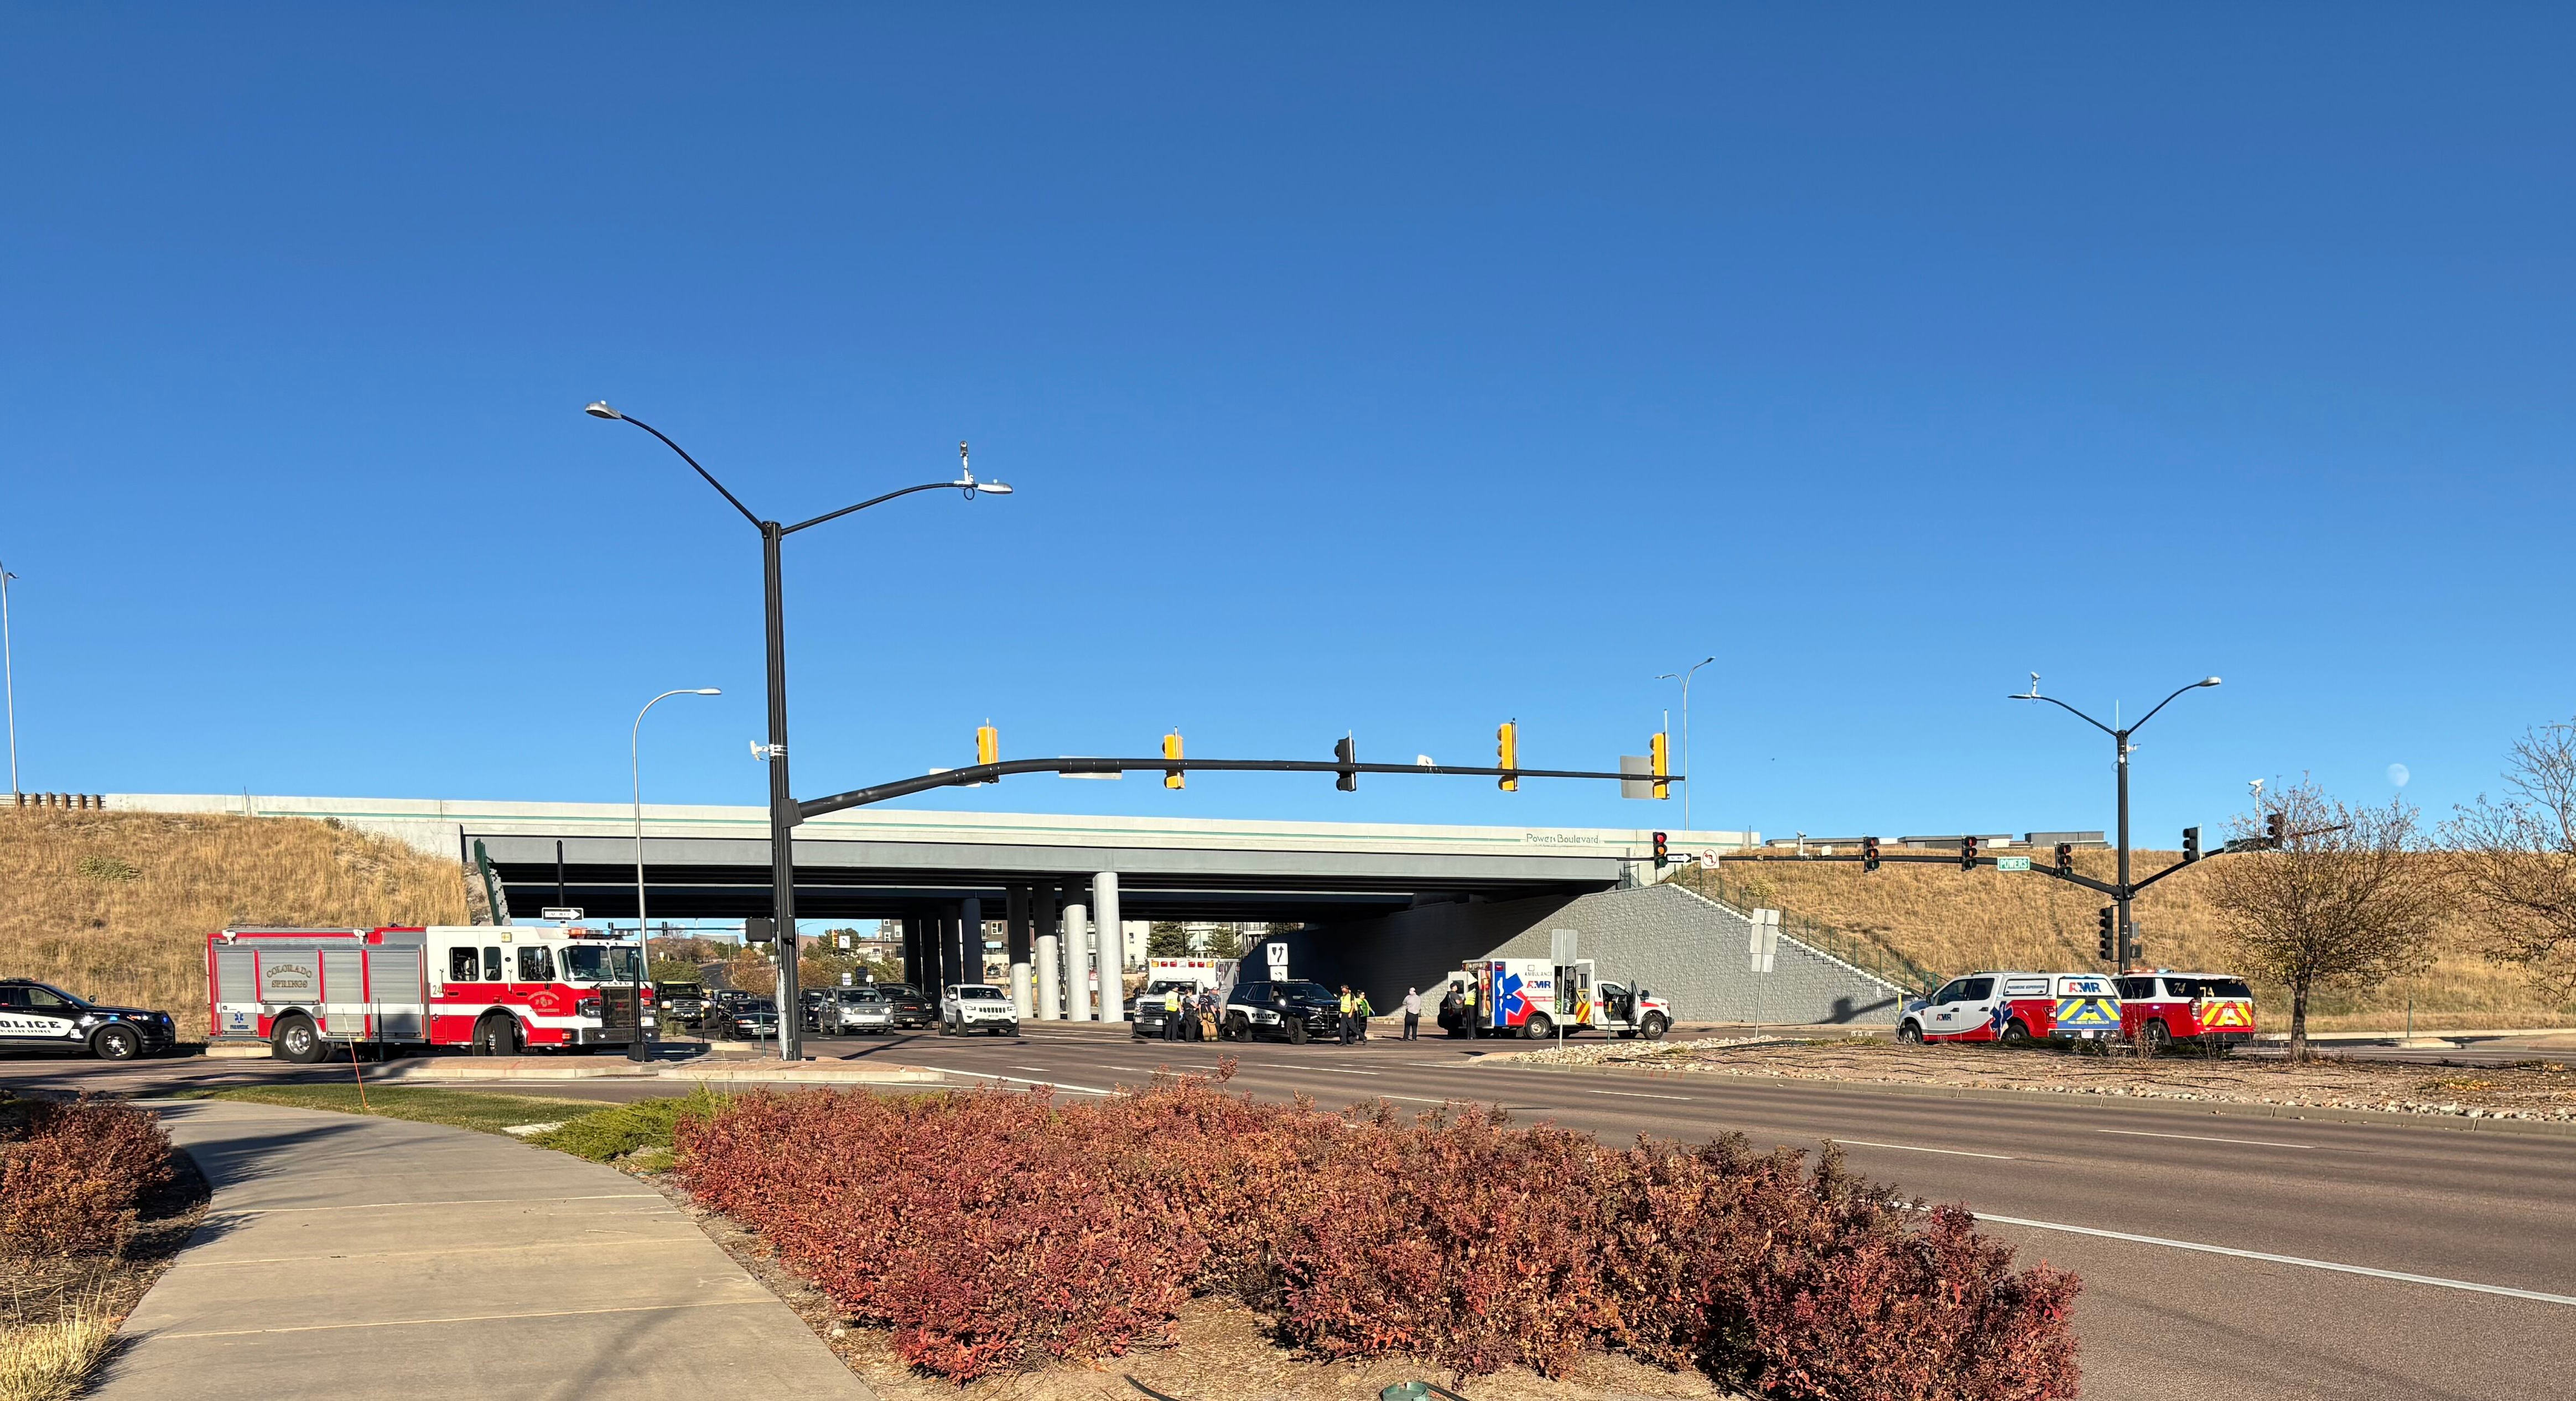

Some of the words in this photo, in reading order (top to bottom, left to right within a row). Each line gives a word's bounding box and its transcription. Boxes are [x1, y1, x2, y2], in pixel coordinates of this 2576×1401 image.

[1557, 834, 1598, 843] Boulevard
[1999, 859, 2028, 868] POWERS
[267, 964, 313, 978] COLORADO
[433, 985, 442, 995] 24
[2069, 982, 2101, 992] AMR
[2173, 982, 2186, 993] 74
[2200, 986, 2215, 997] 74
